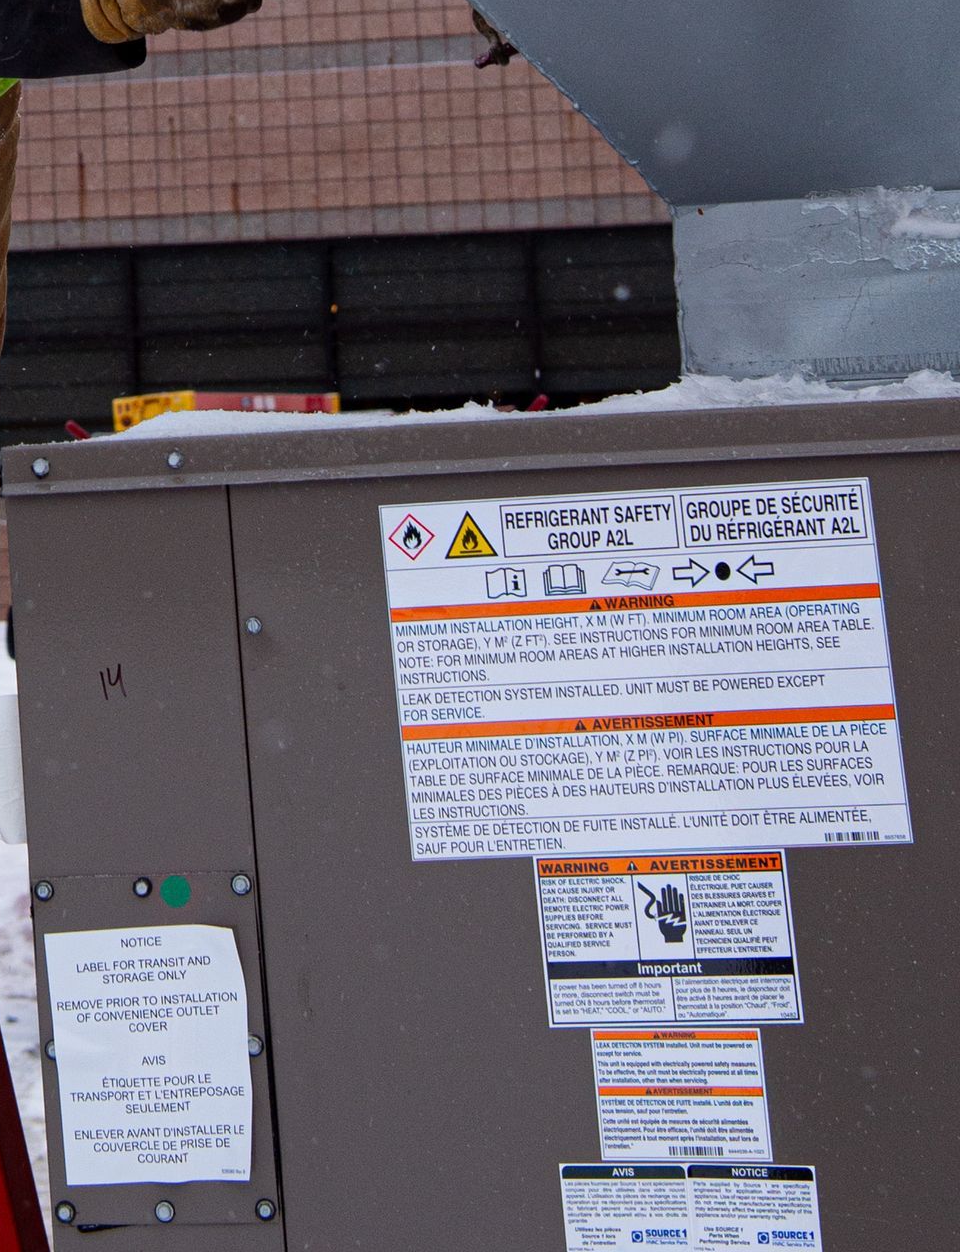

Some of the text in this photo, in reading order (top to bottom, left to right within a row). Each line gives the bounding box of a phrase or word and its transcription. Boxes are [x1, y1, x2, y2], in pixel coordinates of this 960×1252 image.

[686, 488, 860, 520] GROUPE DE SÉCURITÉ
[504, 503, 671, 530] REFRIGERANT SAFETY
[690, 515, 861, 542] DU RÉFRIGÉRANT A2L
[547, 528, 634, 551] GROUP A2L
[605, 595, 675, 609] WARNING
[395, 601, 860, 637] MINIMUM INSTALLATION HEIGHT, X M (W FT). MINIMUM ROOM AREA (OPERATING
[396, 640, 415, 654] OR
[417, 637, 481, 653] STORAGE),
[483, 637, 491, 649] Y
[511, 635, 523, 650] (Z
[553, 632, 577, 646] SEE
[579, 627, 669, 644] INSTRUCTIONS
[671, 626, 697, 639] FOR
[699, 623, 754, 638] MINIMUM
[756, 621, 794, 635] ROOM
[796, 620, 831, 633] AREA
[831, 617, 875, 632] TABLE.
[398, 635, 841, 669] NOTE: FOR MINIMUM ROOM AREAS AT HIGHER INSTALLATION HEIGHTS, SEE
[400, 669, 490, 685] INSTRUCTIONS.
[401, 674, 826, 706] LEAK DETECTION SYSTEM INSTALLED. UNIT MUST BE POWERED EXCEPT
[403, 706, 485, 722] FOR SERVICE.
[592, 714, 714, 730] AVERTISSEMENT
[406, 721, 888, 755] HAUTEUR MINIMALE D'INSTALLATION, X M (W PI). SURFACE MINIMALE DE LA PIÈCE
[414, 807, 873, 839] SYSTÈME DE DÉTECTION DE FUITE INSTALLÉ. L'UNITÉ DOIT ÊTRE ALIMENTÉE,
[416, 837, 566, 855] SAUF POUR L'ENTRETIEN.
[540, 862, 609, 874] WARNING
[649, 856, 779, 871] AVERTISSEMENT
[541, 878, 557, 887] RISK
[557, 878, 567, 886] OF
[568, 877, 600, 886] ELECTRIC
[557, 887, 580, 895] CAUSE
[580, 886, 604, 894] INJURY
[605, 886, 616, 894] OR
[543, 903, 630, 913] REMOTE ELECTRIC POWER
[544, 913, 604, 922] SUPPLIES BEFORE
[120, 936, 162, 948] NOTICE
[547, 939, 611, 949] QUALIFIED SERVICE
[76, 955, 211, 974] LABEL FOR TRANSIT AND
[637, 962, 703, 976] Important
[102, 969, 187, 985] STORAGE ONLY
[56, 991, 238, 1012] REMOVE PRIOR TO INSTALLATION
[76, 1004, 220, 1024] OF CONVENIENCE OUTLET
[128, 1021, 168, 1033] COVER
[659, 1031, 698, 1040] WARNING
[141, 1055, 166, 1066] AVIS
[102, 1073, 212, 1089] ÉTIQUETTE POUR LE
[69, 1085, 245, 1102] TRANSPORT ET L'ENTREPOSAGE
[653, 1087, 713, 1096] AVERTISSEMENT
[125, 1100, 191, 1115] SEULEMENT
[74, 1124, 245, 1141] ENLEVER AVANT D'INSTALLER LE
[93, 1137, 231, 1153] COUVERCLE DE PRISE DE
[137, 1152, 189, 1164] COURANT
[612, 1168, 634, 1177] AVIS
[731, 1168, 768, 1177] NOTICE
[645, 1228, 687, 1238] SOURCE 1
[772, 1231, 815, 1240] SOURCE 1
